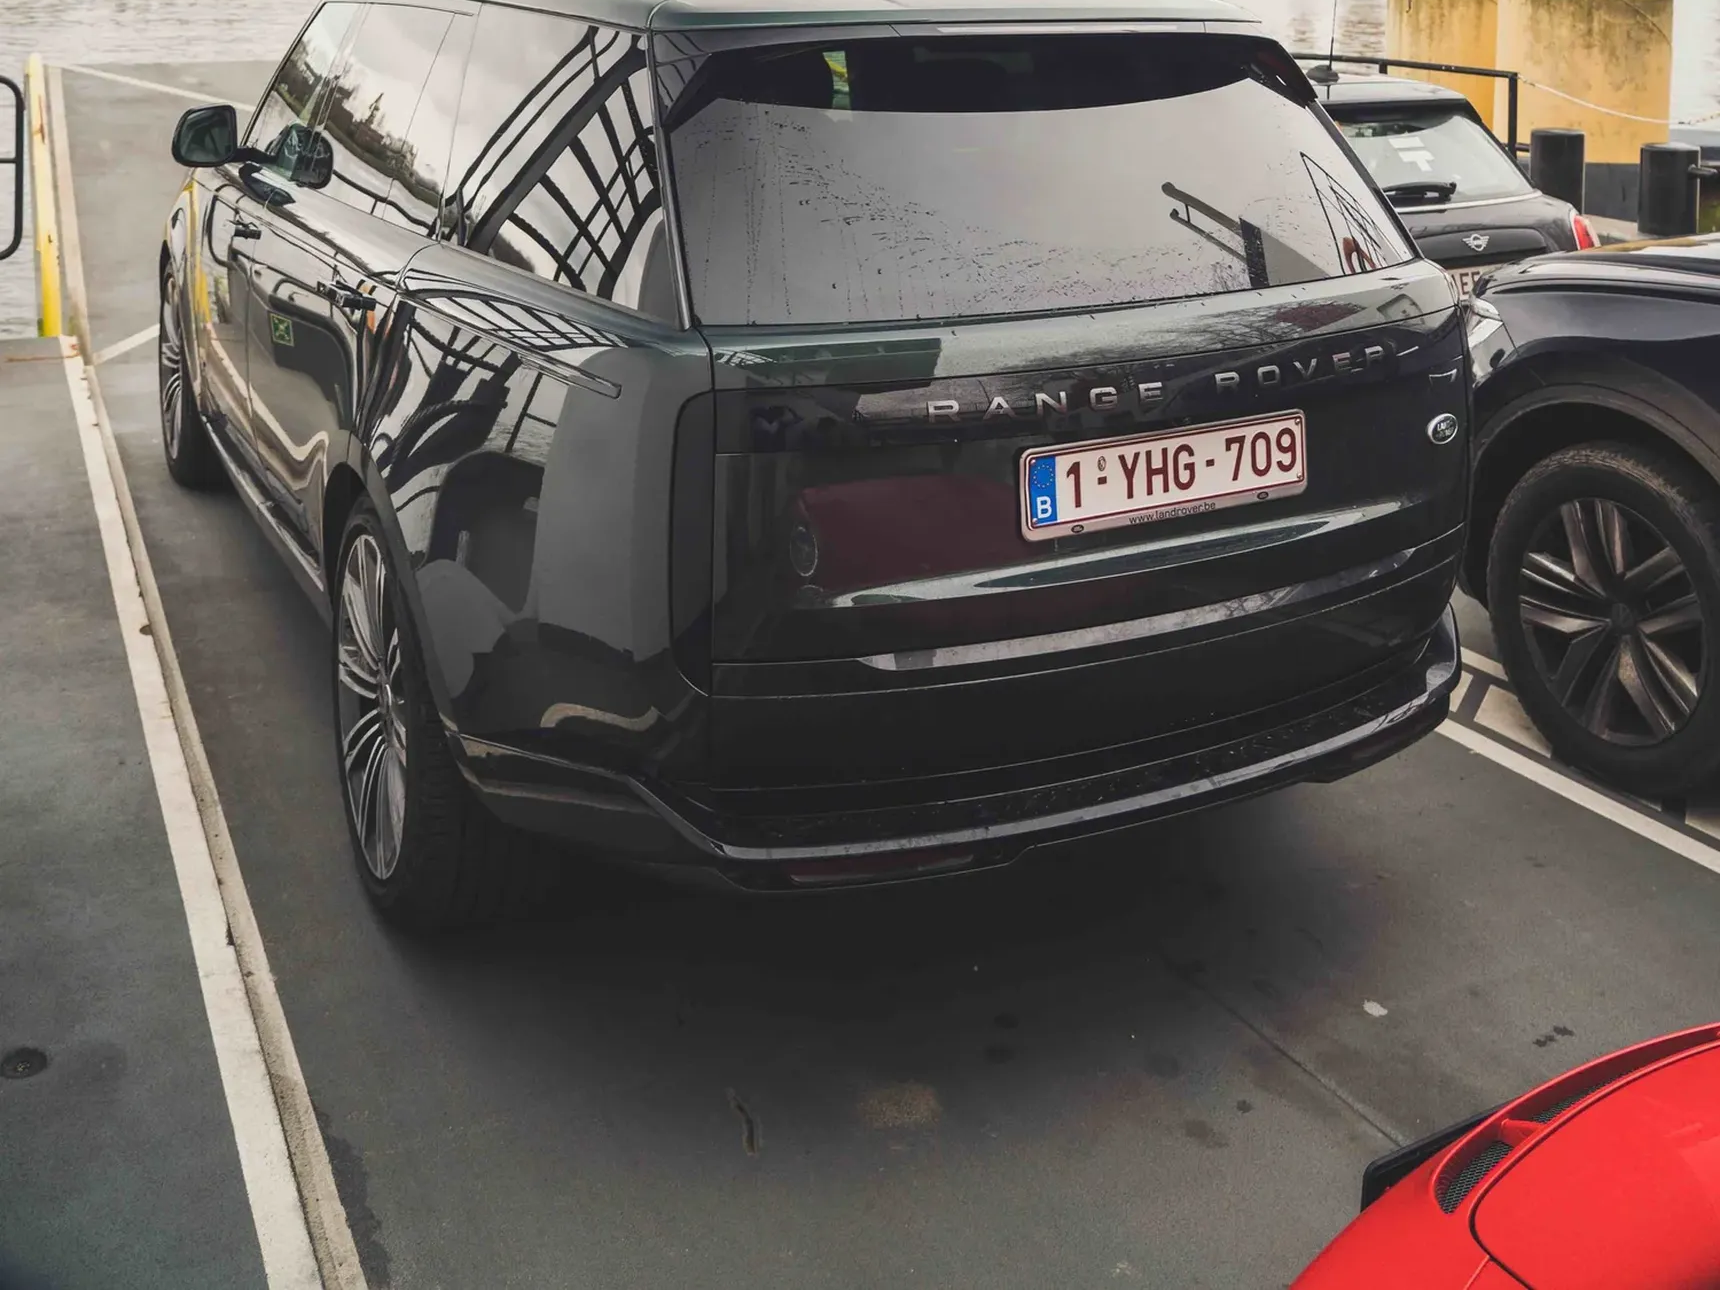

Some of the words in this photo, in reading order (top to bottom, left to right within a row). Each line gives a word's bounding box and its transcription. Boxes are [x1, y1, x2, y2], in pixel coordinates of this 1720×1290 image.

[927, 381, 1163, 423] RANGE
[1066, 427, 1297, 508] 1-YHG-709
[1036, 496, 1053, 519] B
[1128, 501, 1216, 524] www.landrover.be
